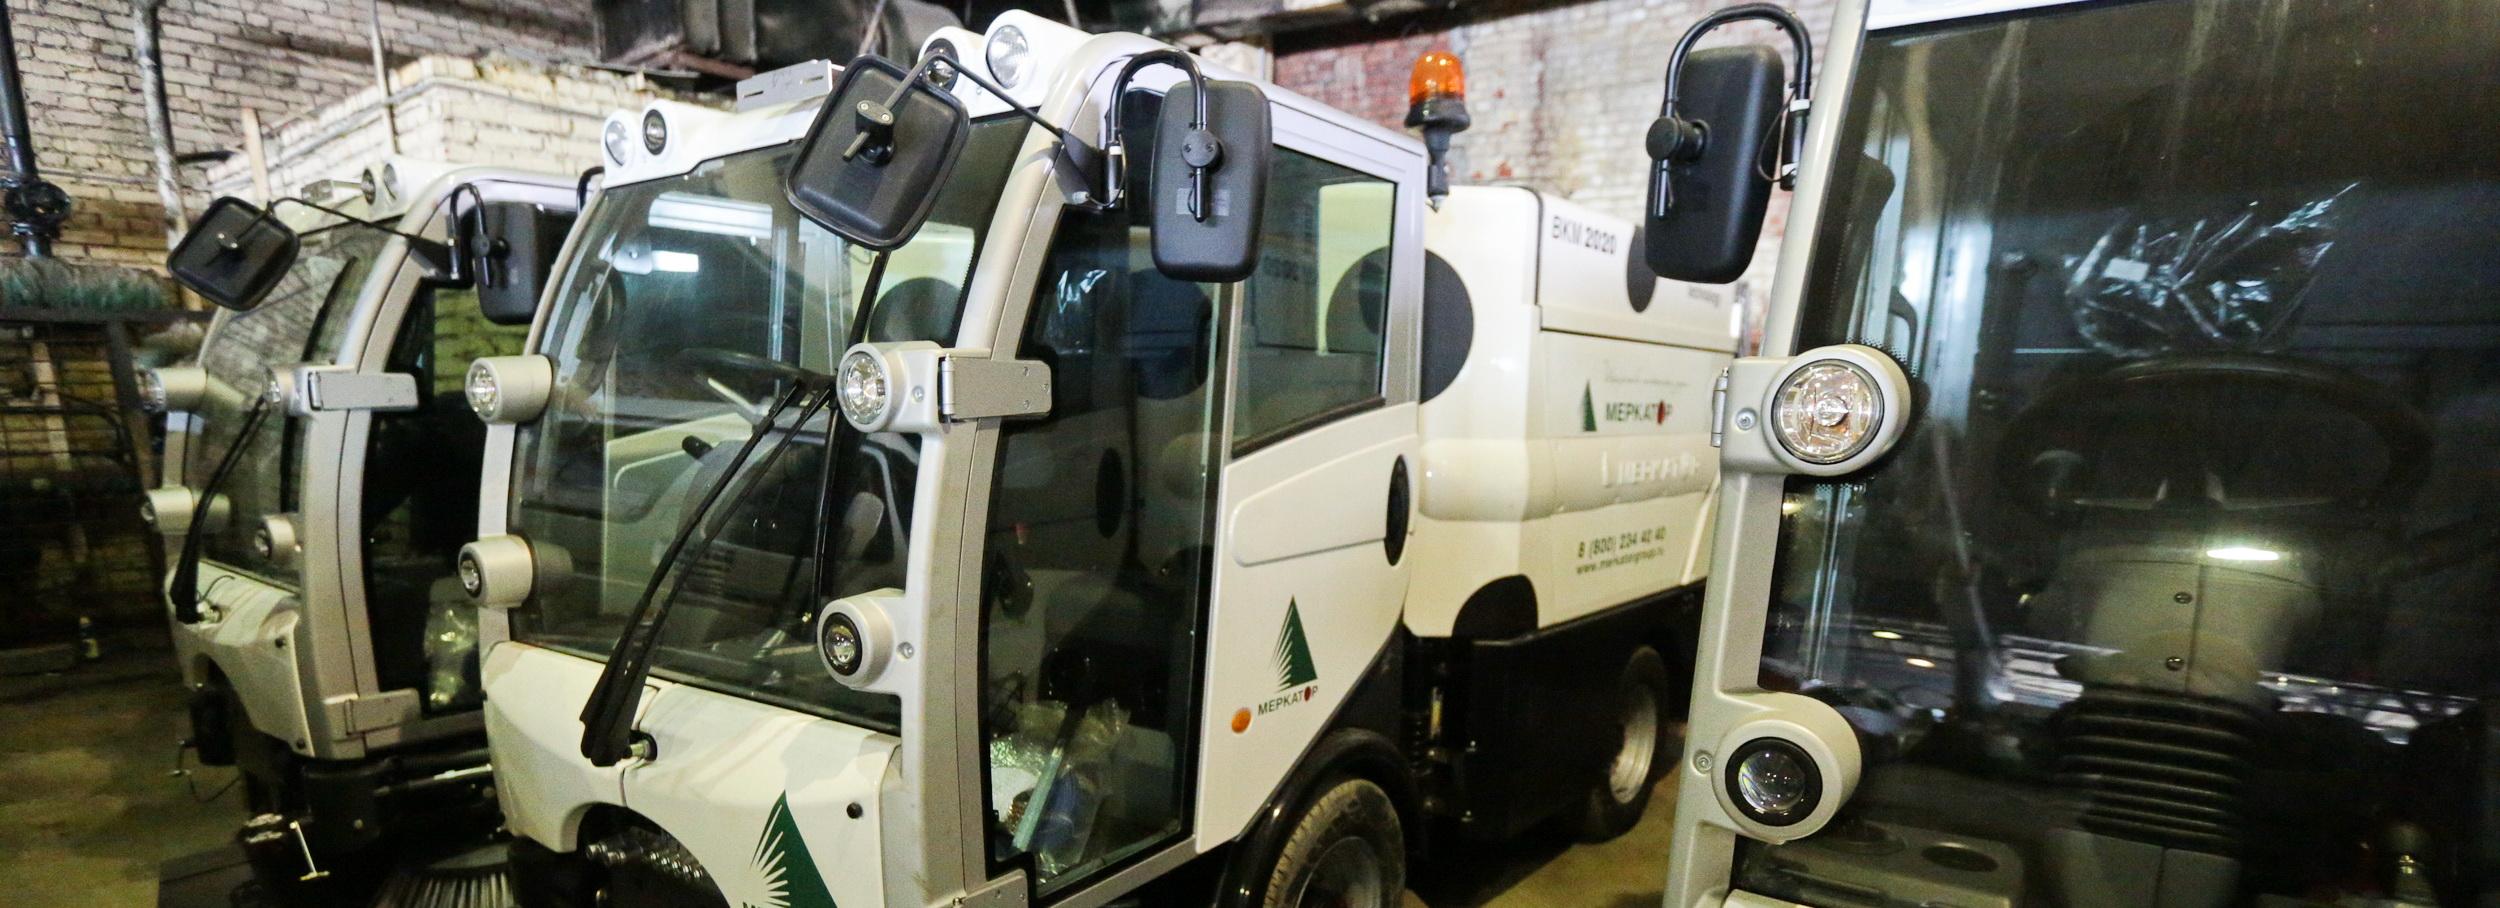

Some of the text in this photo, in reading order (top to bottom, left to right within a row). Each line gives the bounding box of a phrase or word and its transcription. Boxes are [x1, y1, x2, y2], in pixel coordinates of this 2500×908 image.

[1584, 226, 1617, 255] 2020
[1605, 400, 1673, 425] МЕРКАТОР
[1578, 525, 1667, 560] 8 (800) 234 40 40
[1257, 684, 1318, 716] МЕРКАТОР
